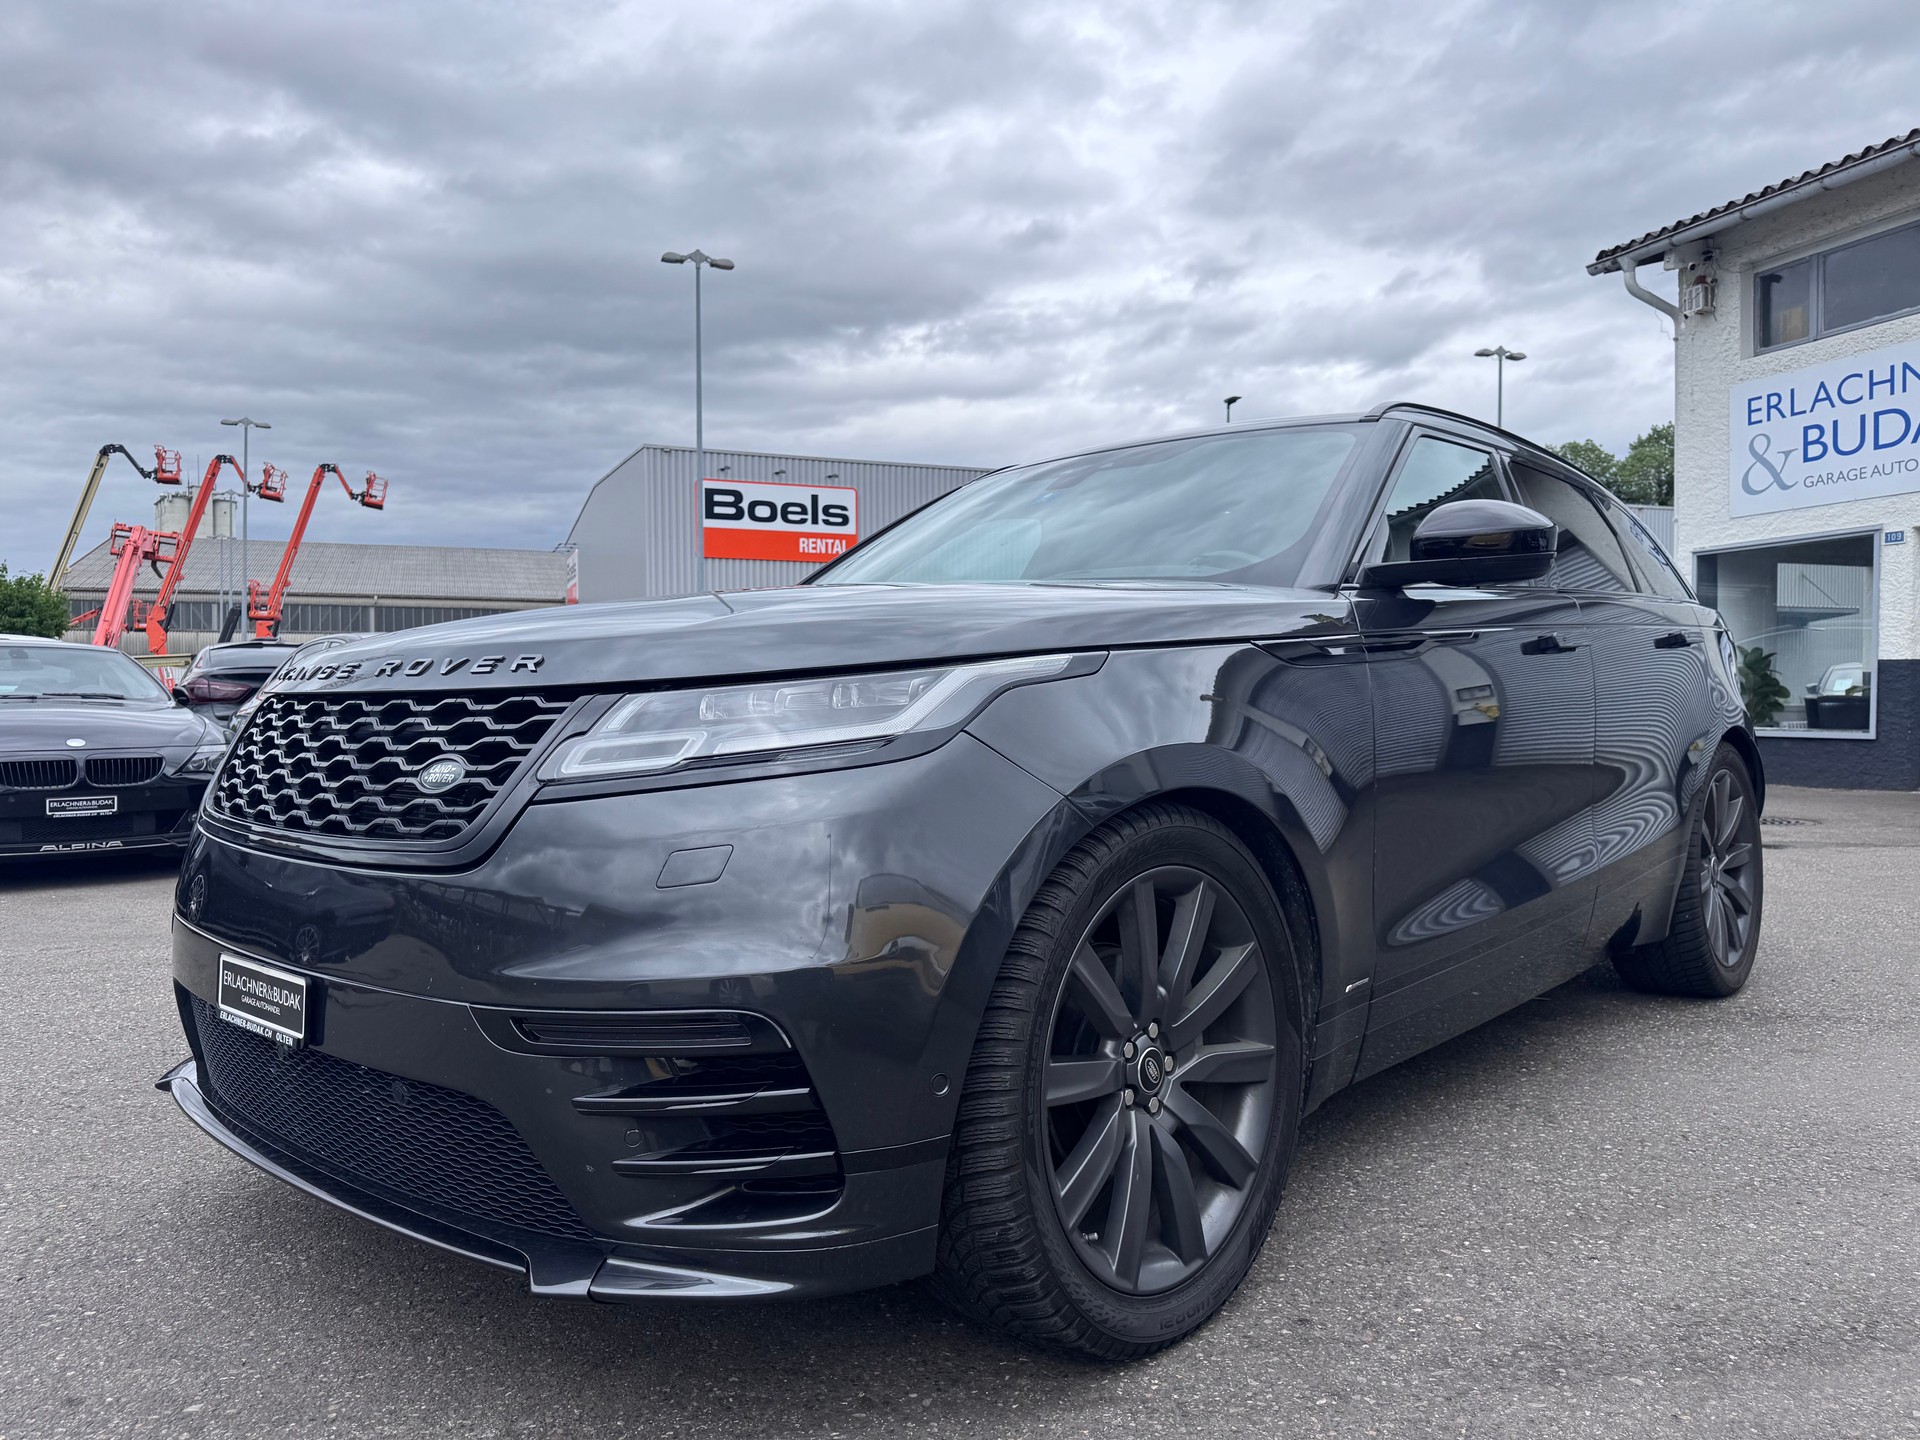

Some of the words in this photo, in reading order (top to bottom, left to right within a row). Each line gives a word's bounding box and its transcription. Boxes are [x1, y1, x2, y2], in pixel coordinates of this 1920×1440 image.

[1741, 433, 1798, 496] &
[1803, 466, 1868, 488] GARAGE
[1870, 458, 1919, 478] AUTO
[704, 487, 850, 527] Boels
[1887, 532, 1902, 541] 109
[374, 653, 546, 677] ROVER
[429, 764, 453, 773] LAND
[426, 773, 455, 783] ROVER
[39, 840, 123, 852] ALPINA
[275, 1032, 293, 1046] OLTEN
